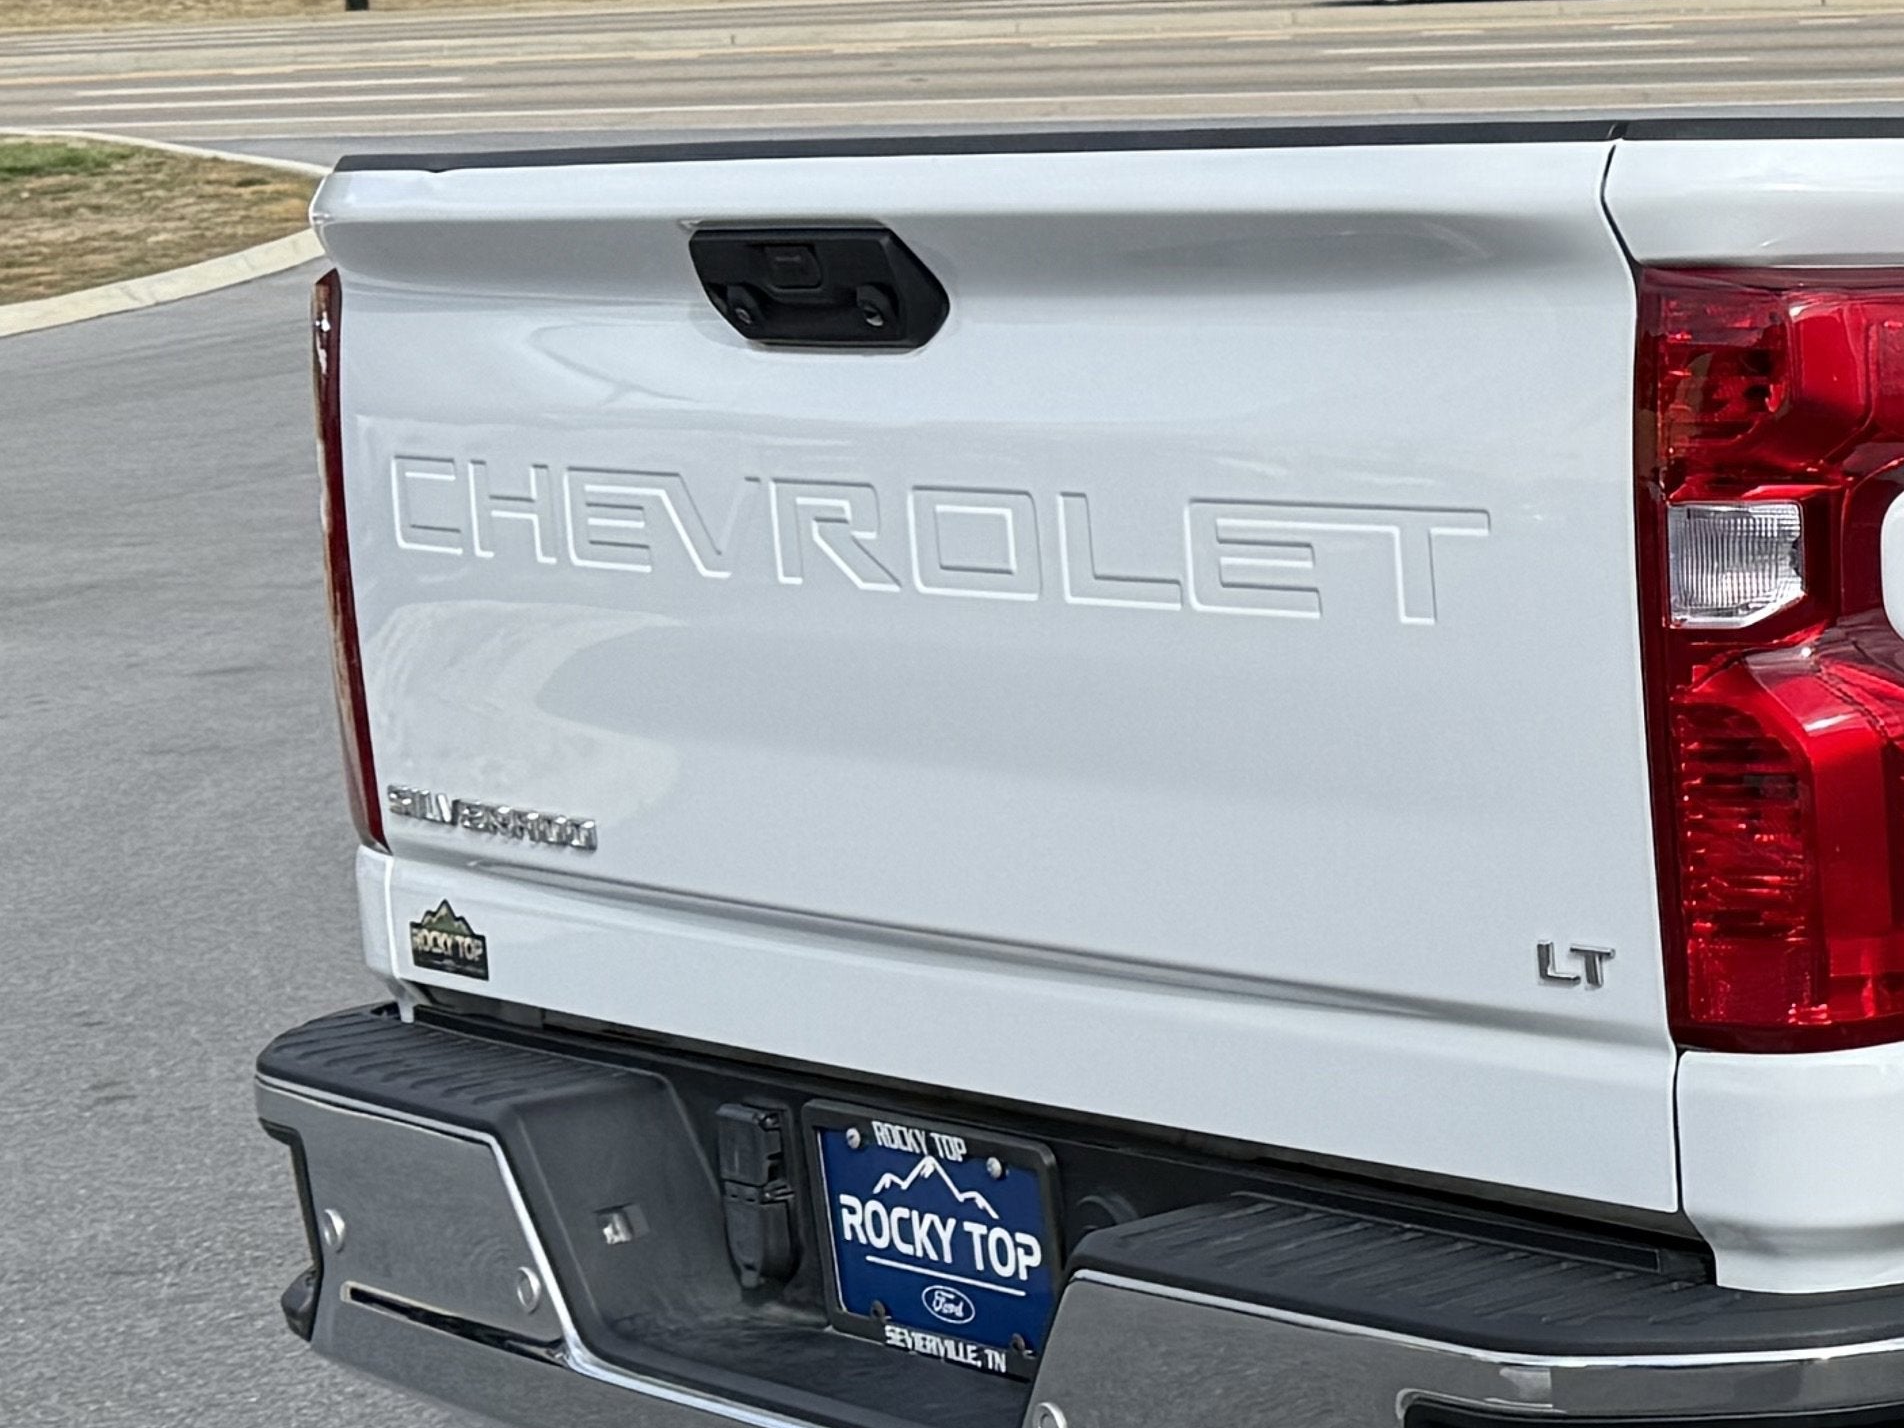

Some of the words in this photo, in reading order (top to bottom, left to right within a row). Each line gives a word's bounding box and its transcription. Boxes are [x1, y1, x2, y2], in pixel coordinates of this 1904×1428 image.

[391, 455, 1491, 625] CHEVROLET
[1537, 941, 1616, 990] LT
[871, 1120, 928, 1155] ROCKY
[930, 1132, 967, 1162] TOP
[839, 1194, 957, 1263] ROCKY
[963, 1221, 1042, 1281] TOP
[932, 1289, 965, 1318] Ford
[984, 1348, 1007, 1373] TN
